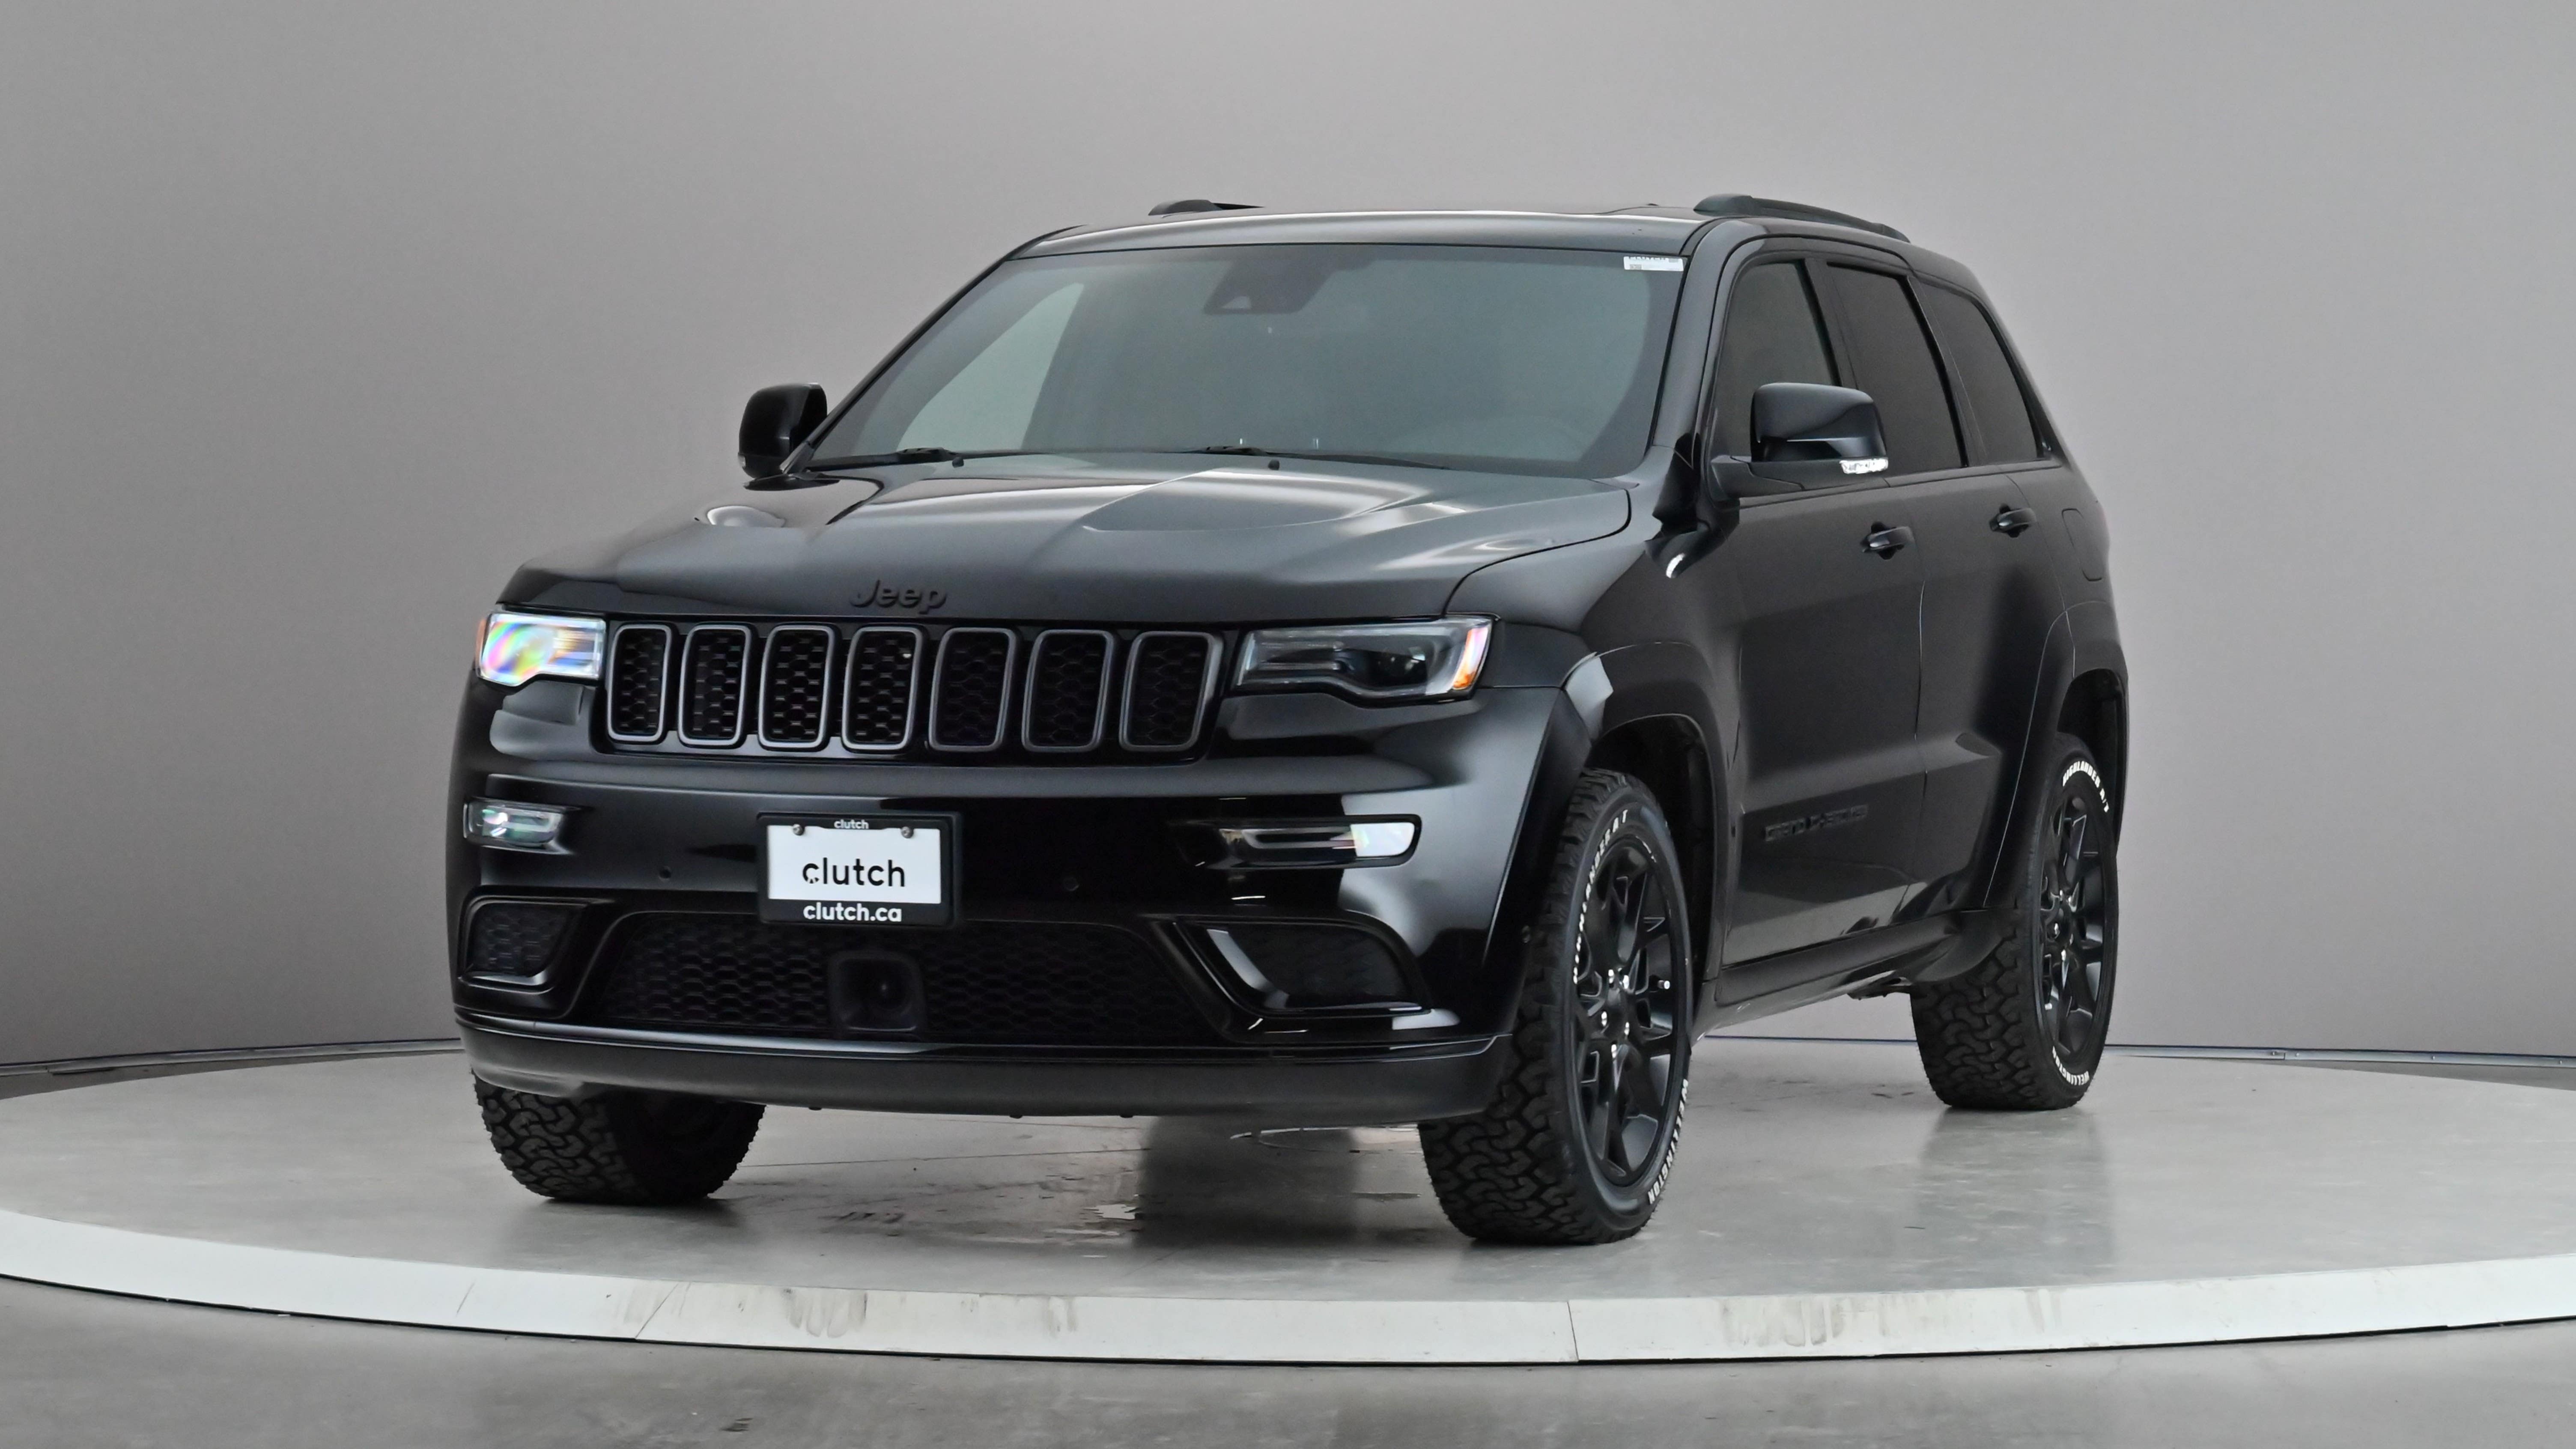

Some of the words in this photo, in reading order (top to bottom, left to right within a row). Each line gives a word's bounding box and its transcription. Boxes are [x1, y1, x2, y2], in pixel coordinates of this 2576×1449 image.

[850, 579, 947, 615] Jeep
[834, 819, 869, 830] clutch
[802, 857, 905, 887] clutch
[803, 902, 902, 922] clutch.ca
